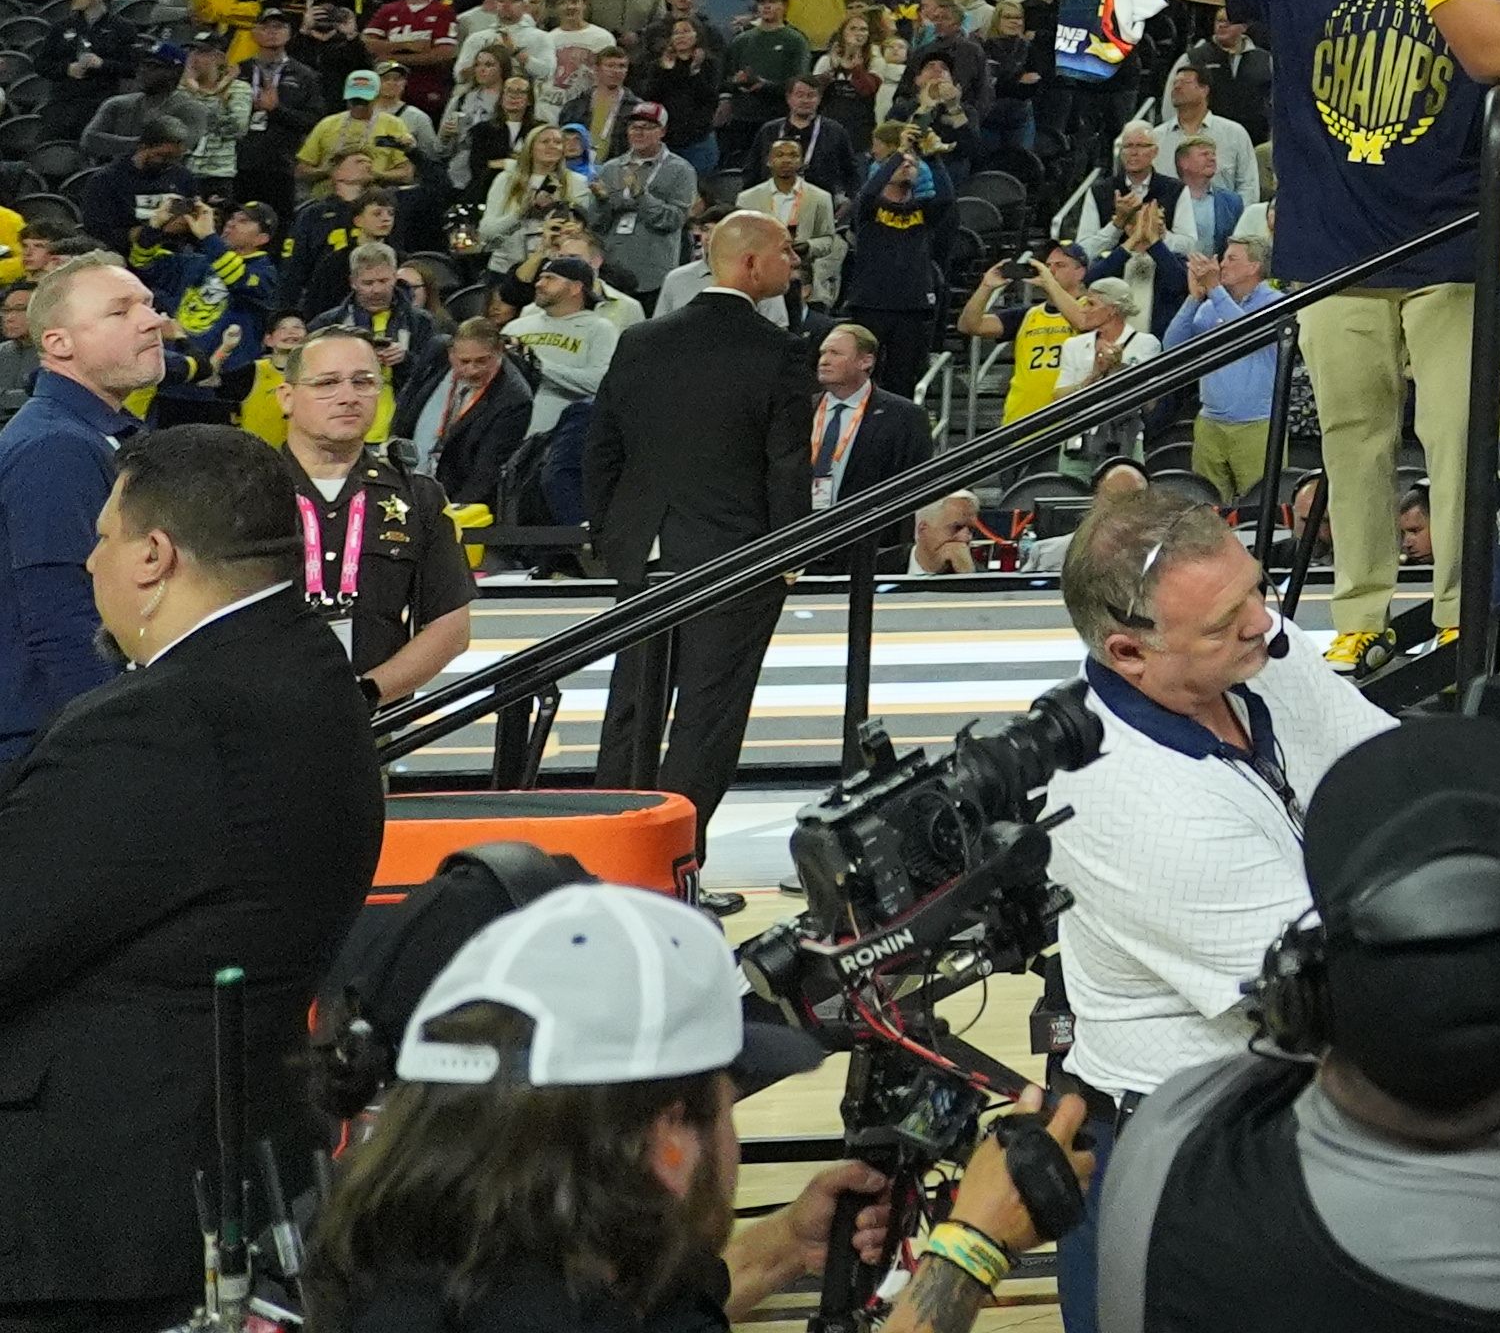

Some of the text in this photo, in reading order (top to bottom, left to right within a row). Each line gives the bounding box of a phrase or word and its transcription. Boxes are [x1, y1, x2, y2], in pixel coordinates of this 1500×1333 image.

[1312, 30, 1454, 128] CHAMPS
[1347, 130, 1387, 165] M
[1030, 345, 1062, 369] 23
[840, 928, 914, 974] RONIN
